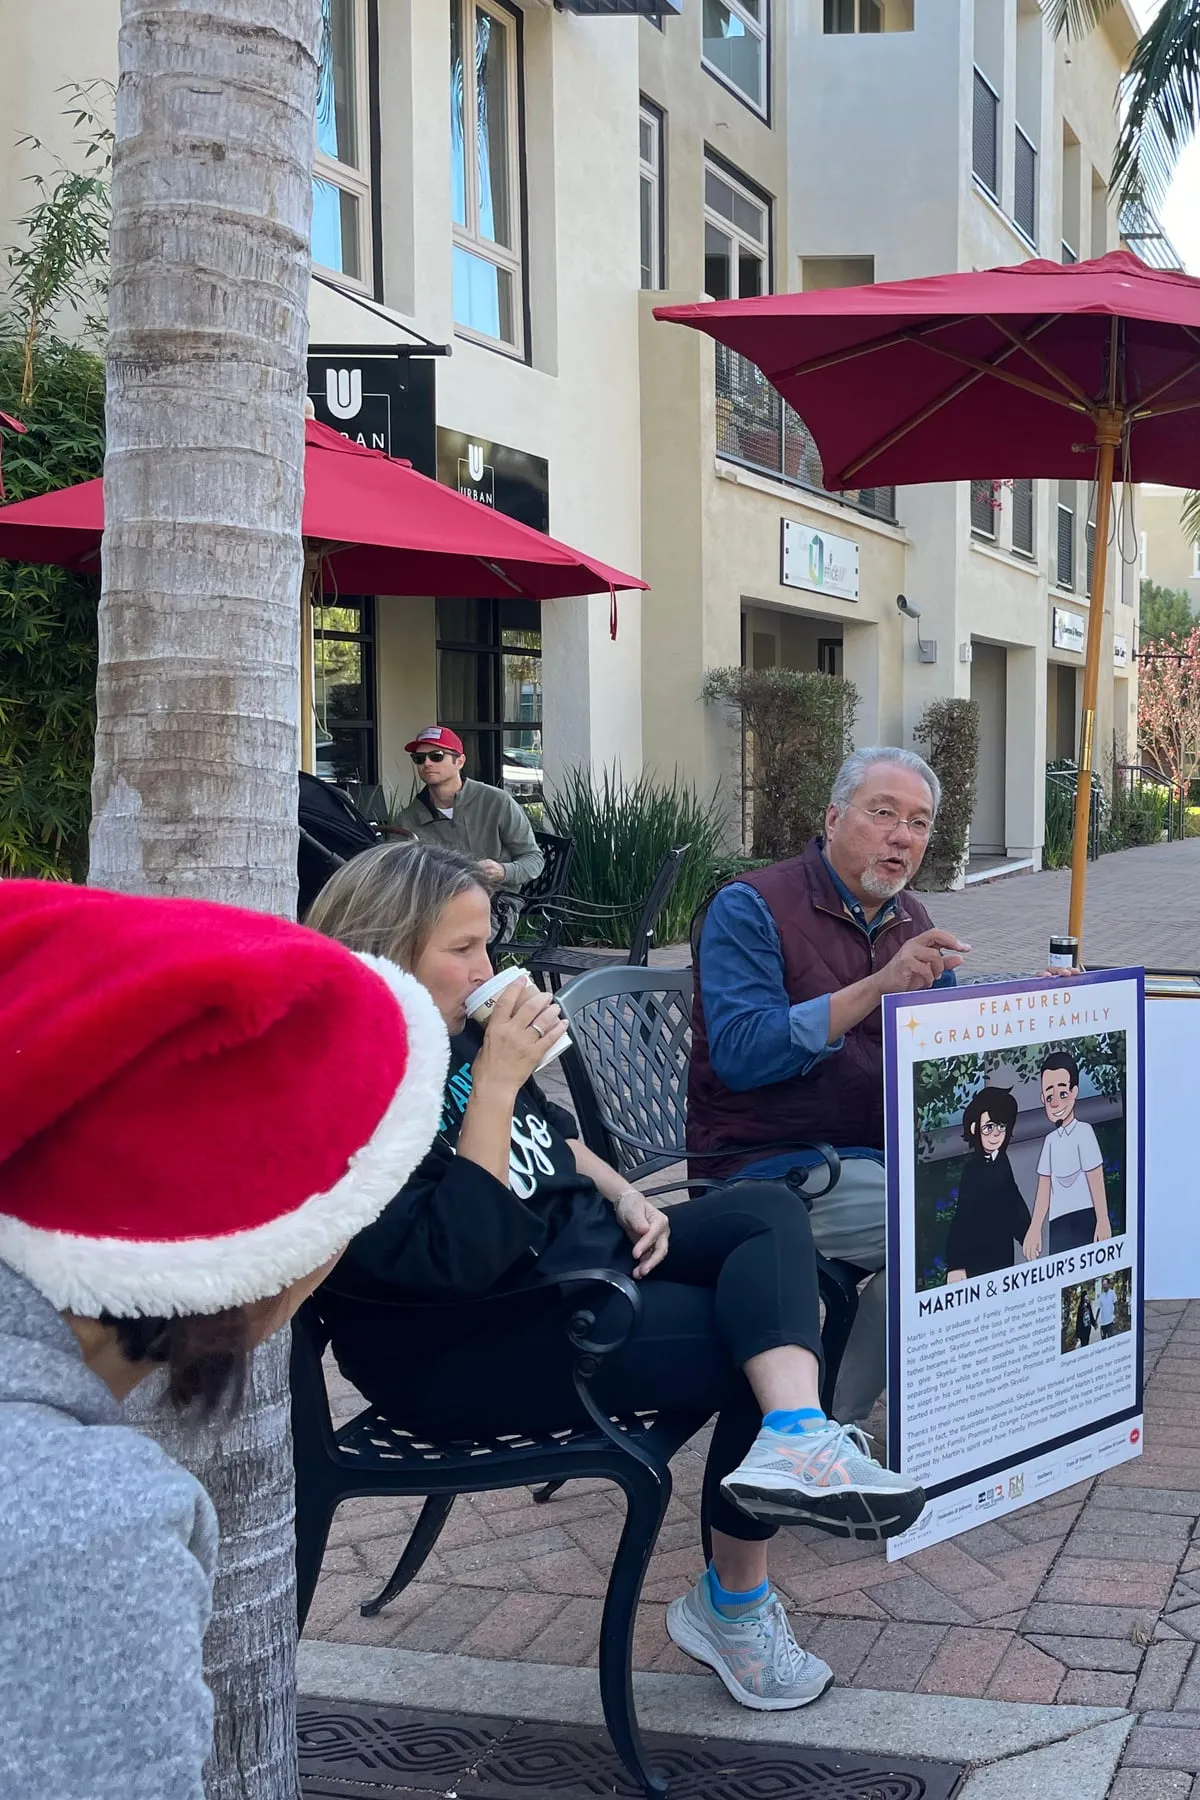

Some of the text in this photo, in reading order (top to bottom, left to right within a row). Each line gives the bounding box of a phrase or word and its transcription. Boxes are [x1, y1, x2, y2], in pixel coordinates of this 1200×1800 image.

[326, 369, 362, 419] U
[468, 444, 483, 481] U
[461, 486, 492, 504] URBAN
[934, 1008, 1111, 1044] GRADUATE FAMILY
[979, 992, 1072, 1016] FEATURED
[919, 1242, 1125, 1318] MARTIN & SKYELUR'S STORY
[906, 1331, 926, 1342] Martin
[945, 1319, 970, 1332] graduate
[973, 1314, 980, 1322] of
[983, 1309, 1001, 1319] Family
[1004, 1302, 1025, 1312] Promise
[1036, 1293, 1056, 1302] Orange
[906, 1357, 915, 1365] his
[919, 1348, 945, 1361] daughter
[973, 1335, 988, 1343] were
[991, 1329, 1006, 1338] living
[1017, 1321, 1032, 1329] when
[907, 1342, 928, 1353] County
[930, 1338, 943, 1346] who
[944, 1326, 978, 1342] experienced
[991, 1320, 1002, 1328] loss
[1021, 1309, 1036, 1318] home
[1045, 1302, 1055, 1310] and
[906, 1366, 924, 1376] father
[926, 1359, 948, 1370] became
[958, 1349, 976, 1360] Martin
[977, 1341, 1003, 1353] overcame
[1004, 1333, 1030, 1345] numerous
[1031, 1324, 1055, 1336] obstacles
[906, 1385, 937, 1399] separating
[954, 1374, 970, 1383] while
[991, 1360, 1006, 1371] could
[1008, 1357, 1021, 1365] have
[1021, 1350, 1040, 1360] shelter
[1041, 1344, 1055, 1353] while
[918, 1376, 930, 1385] give
[975, 1356, 988, 1365] best
[992, 1348, 1014, 1361] possible
[1032, 1334, 1055, 1346] including
[906, 1428, 928, 1439] Thanks
[937, 1419, 951, 1428] their
[952, 1414, 965, 1423] now
[966, 1407, 984, 1418] stable
[1046, 1377, 1064, 1388] thrived
[1065, 1373, 1075, 1382] and
[1075, 1367, 1093, 1378] tapped
[1113, 1354, 1131, 1363] creative
[906, 1409, 927, 1422] started
[934, 1404, 947, 1412] new
[947, 1396, 969, 1409] journey
[976, 1387, 996, 1398] reunite
[996, 1381, 1009, 1390] with
[917, 1397, 932, 1407] slept
[965, 1380, 983, 1391] Martin
[985, 1373, 1001, 1384] found
[1003, 1367, 1021, 1378] Family
[1023, 1359, 1044, 1370] Promise
[1045, 1354, 1055, 1363] and
[959, 1417, 989, 1431] illustration
[990, 1410, 1006, 1420] above
[1013, 1396, 1045, 1411] hand-drawn
[1094, 1373, 1107, 1381] story
[1112, 1367, 1122, 1376] just
[906, 1454, 913, 1462] of
[915, 1449, 931, 1459] many
[932, 1443, 945, 1452] that
[947, 1436, 965, 1447] Family
[967, 1427, 989, 1439] Promise
[991, 1422, 997, 1430] of
[998, 1416, 1018, 1427] Orange
[1020, 1409, 1039, 1419] County
[1080, 1388, 1093, 1397] hope
[1093, 1383, 1104, 1391] that
[1104, 1380, 1113, 1388] you
[1114, 1375, 1124, 1383] will
[906, 1459, 930, 1473] inspired
[966, 1441, 980, 1451] spirit
[982, 1435, 992, 1445] and
[994, 1431, 1006, 1440] how
[1008, 1424, 1025, 1435] Family
[1027, 1416, 1048, 1427] Promise
[1049, 1407, 1066, 1419] helped
[1068, 1404, 1077, 1412] him
[1092, 1391, 1111, 1403] journey
